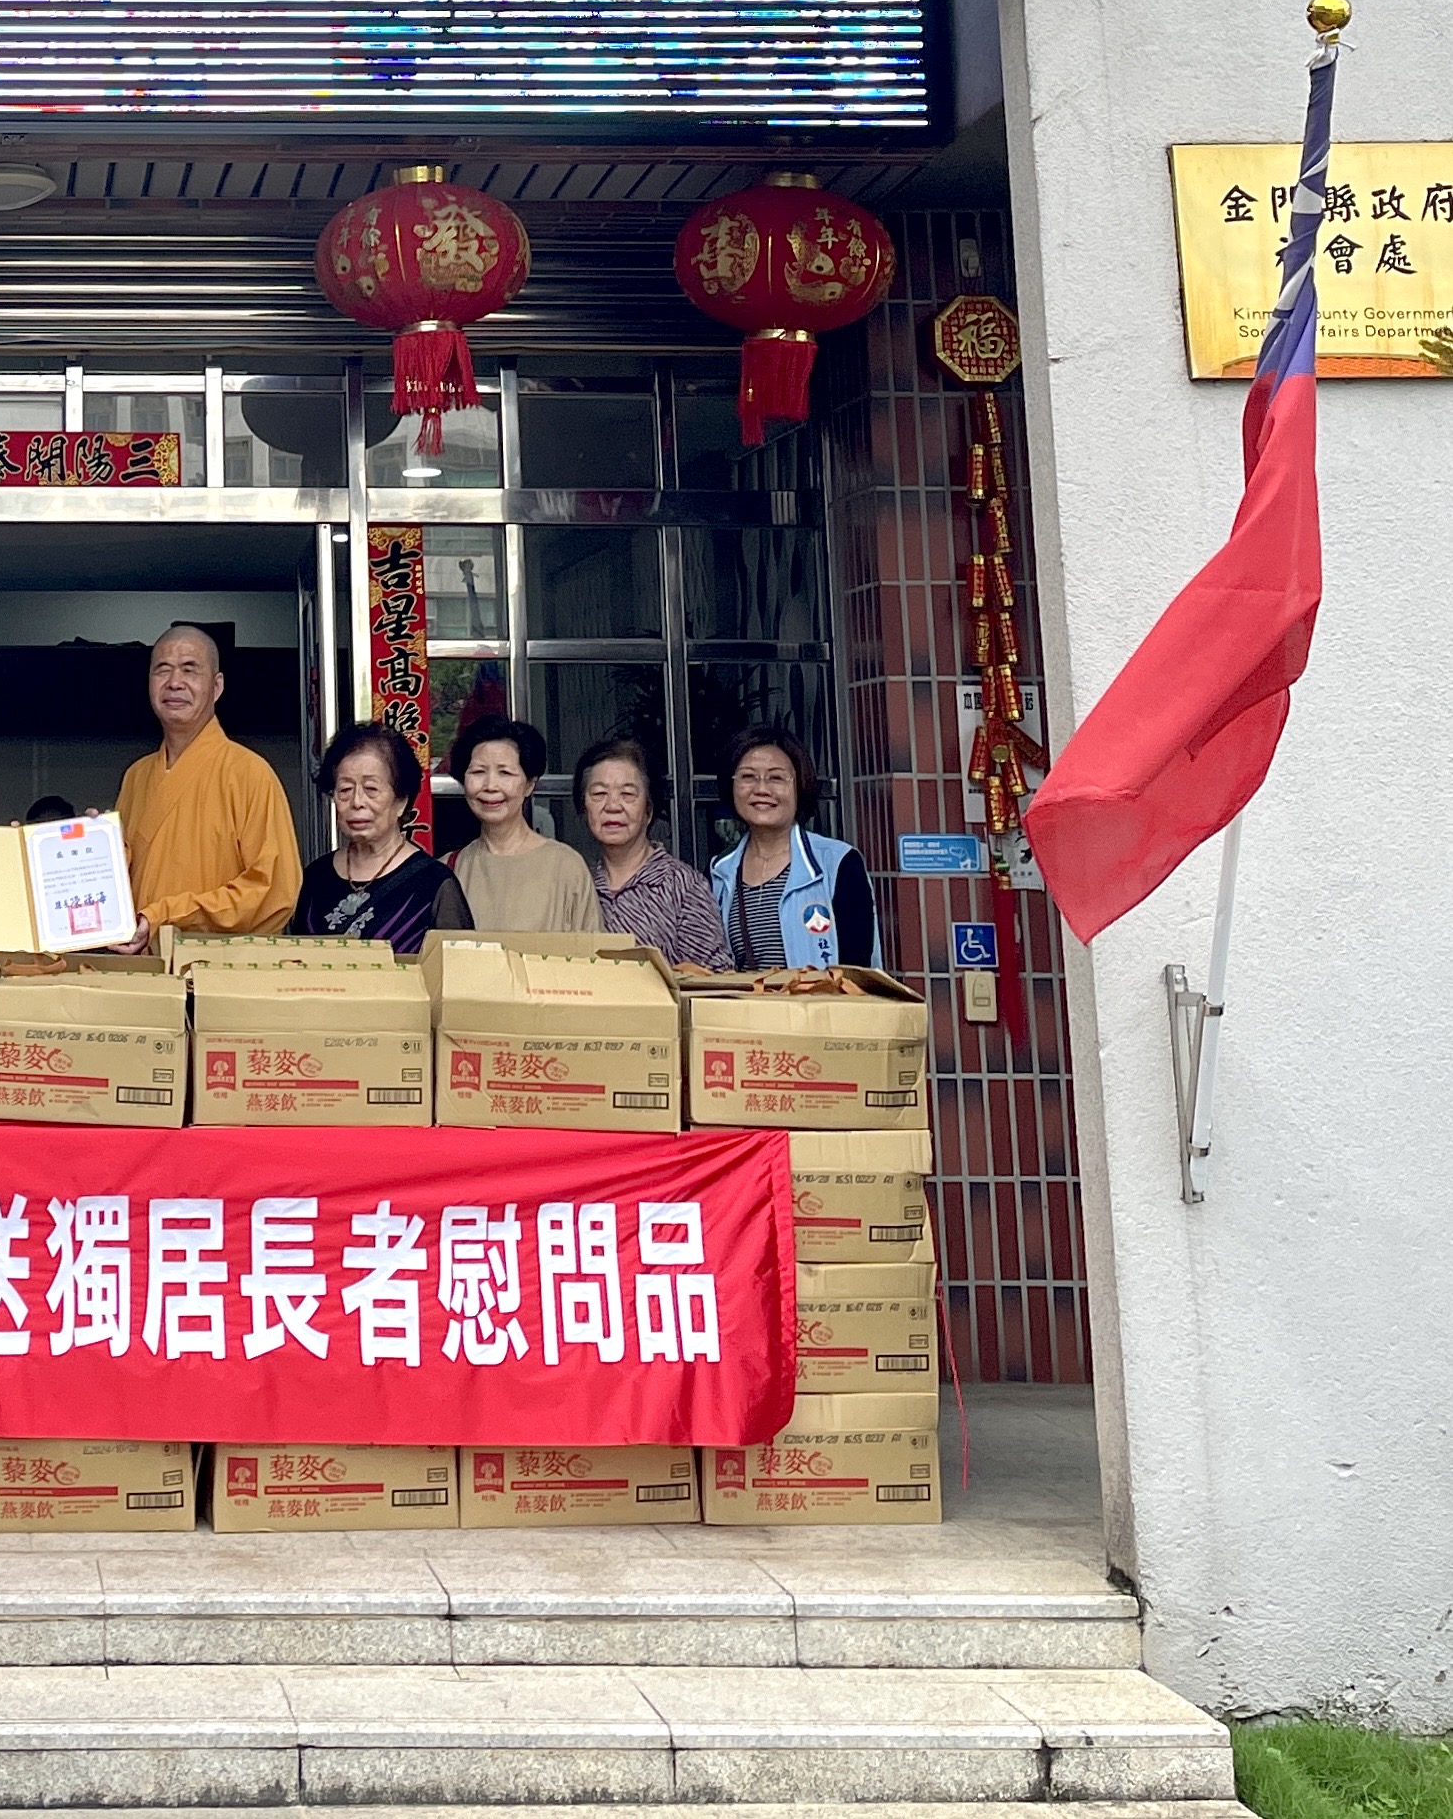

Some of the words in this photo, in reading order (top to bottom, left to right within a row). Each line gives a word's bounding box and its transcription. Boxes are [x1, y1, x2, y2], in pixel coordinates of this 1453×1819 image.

[1275, 234, 1417, 274] 會處
[1233, 308, 1273, 320] Kinm
[1364, 307, 1453, 319] Governmen
[1314, 326, 1359, 337] fairs
[955, 311, 1006, 359] 福
[369, 539, 430, 851] 吉星高照
